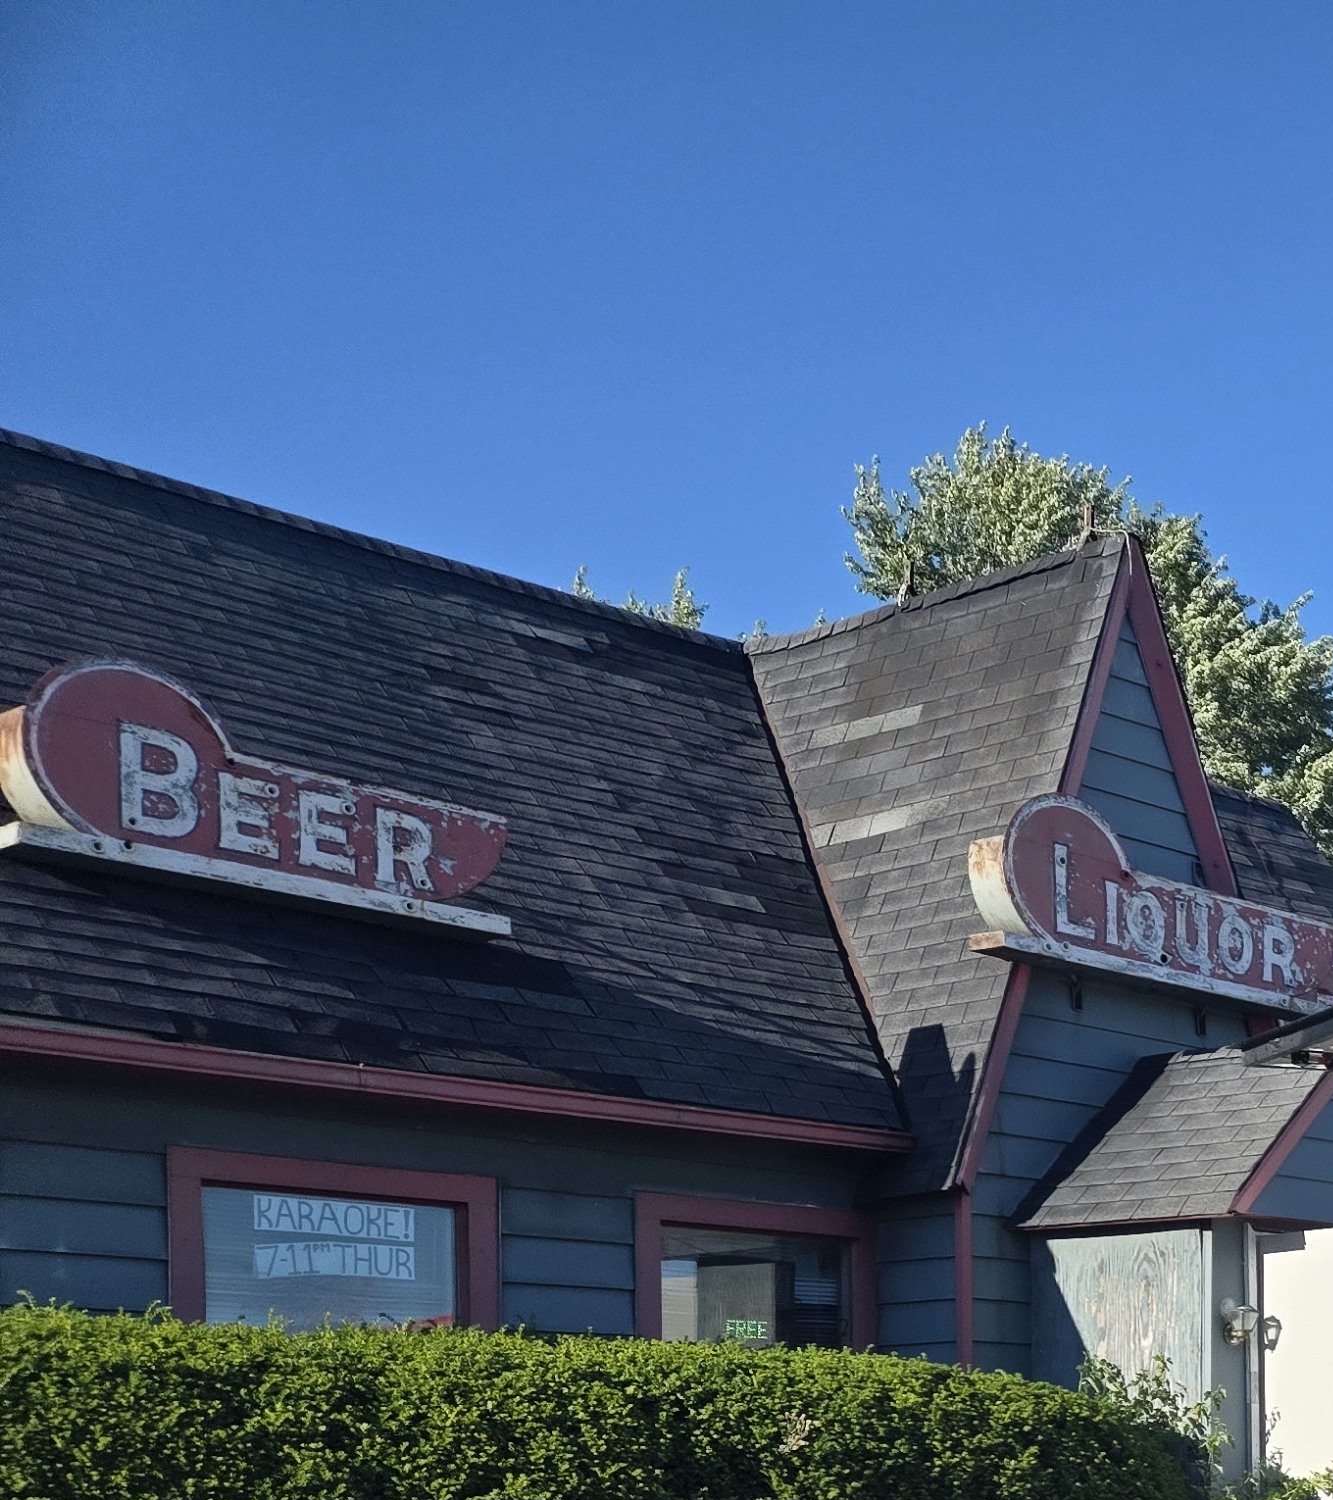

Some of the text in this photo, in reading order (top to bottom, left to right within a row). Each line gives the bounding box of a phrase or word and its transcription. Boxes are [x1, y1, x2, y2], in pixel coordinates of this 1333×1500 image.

[118, 720, 437, 893] BEER
[1053, 843, 1303, 987] LIQUOR
[256, 1197, 412, 1240] KARAOKE!
[333, 1243, 413, 1278] THUR
